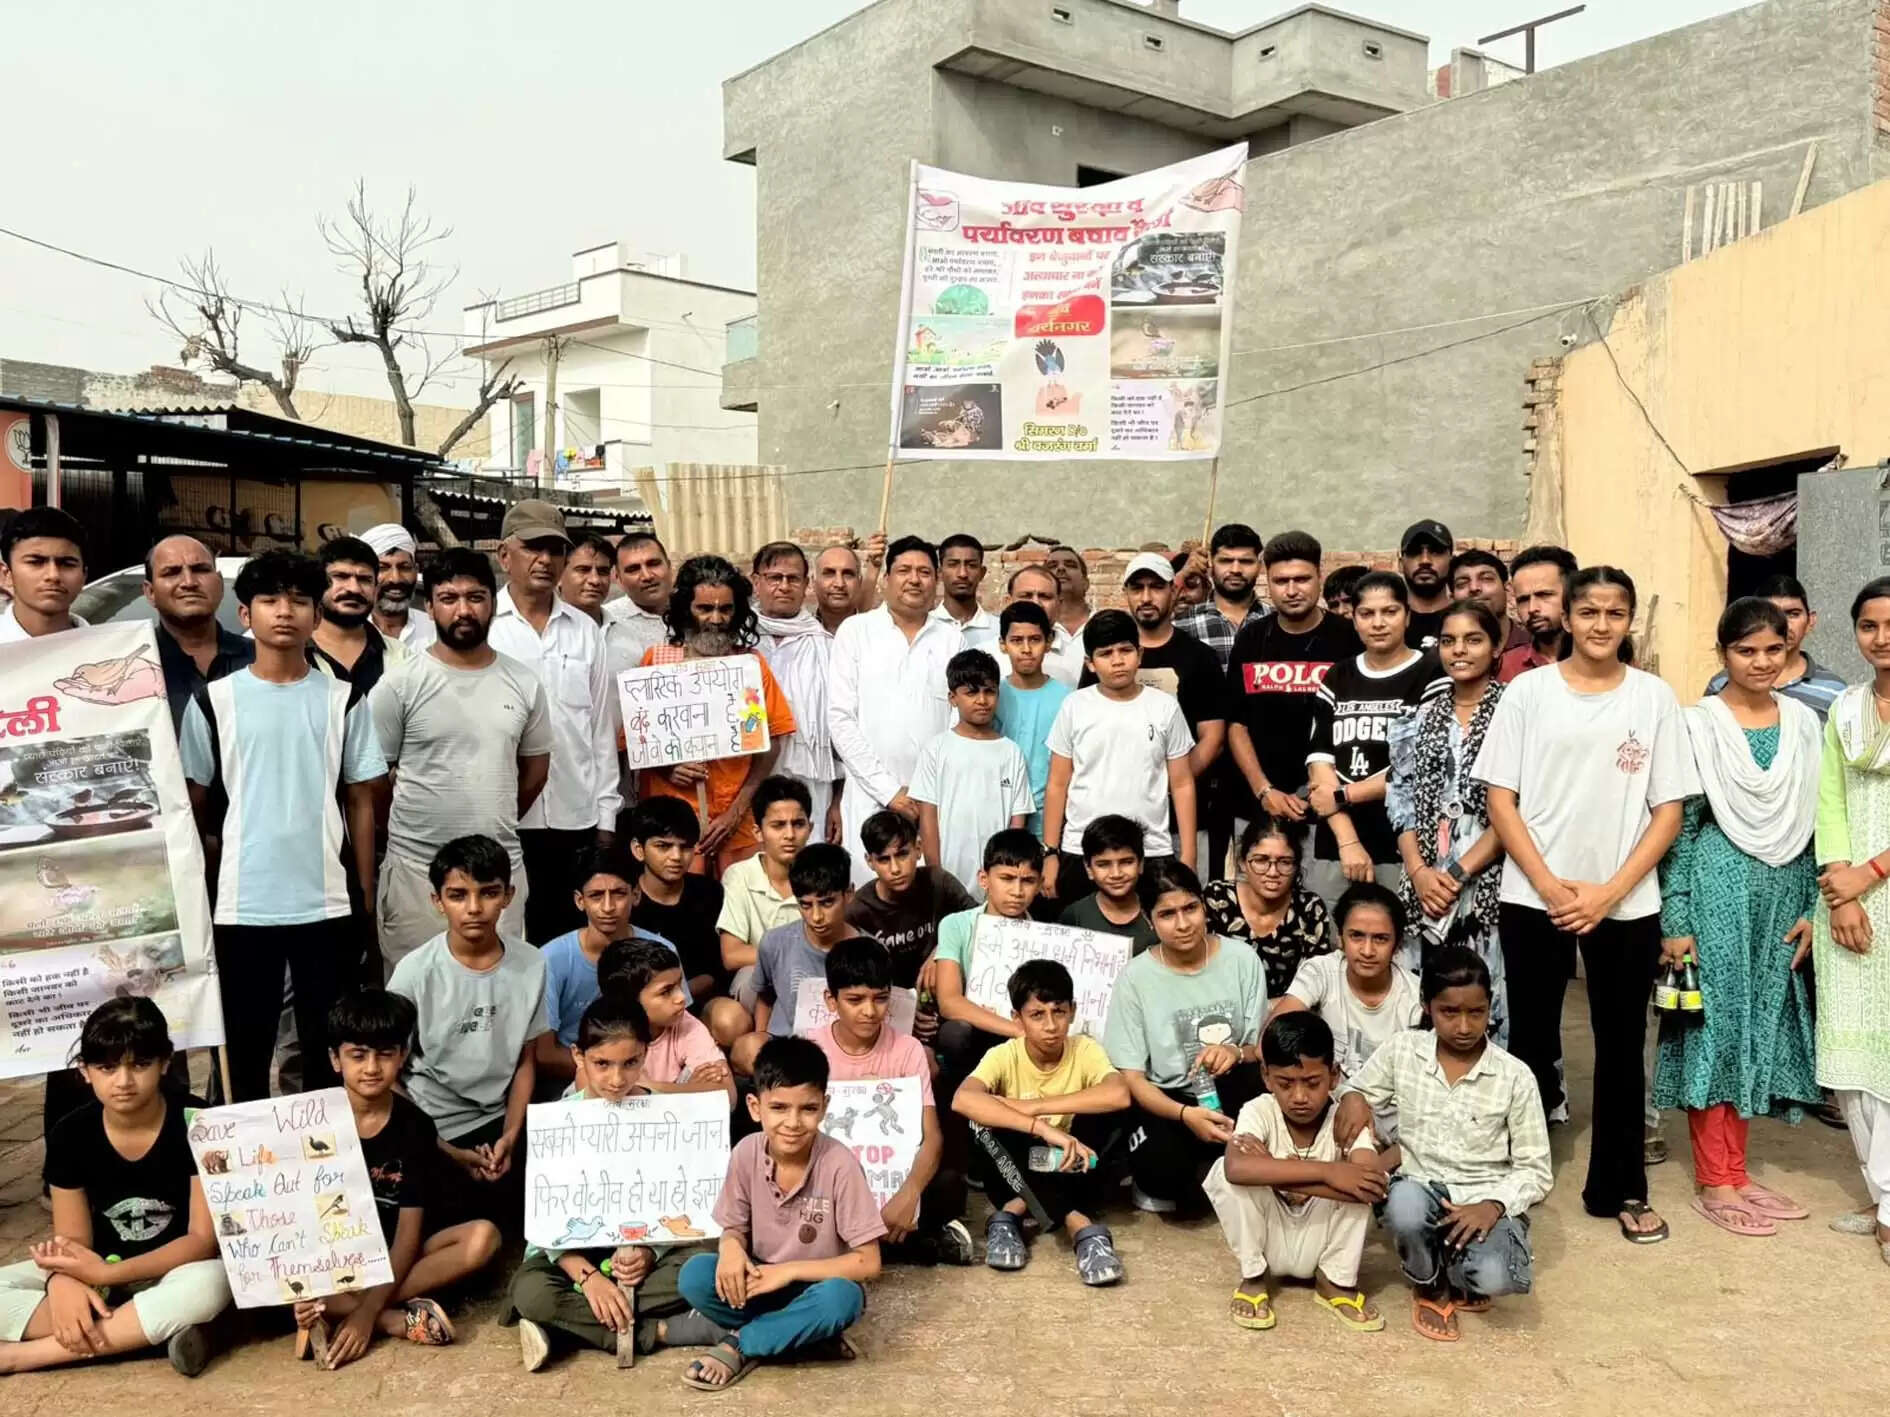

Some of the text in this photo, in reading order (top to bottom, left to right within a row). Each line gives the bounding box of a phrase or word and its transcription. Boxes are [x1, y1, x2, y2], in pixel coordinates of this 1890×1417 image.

[962, 221, 1065, 245] पर्यावरण
[1067, 226, 1130, 245] बचाव
[2, 976, 27, 988] किसी
[63, 969, 80, 979] नहीं
[3, 987, 28, 998] किसी
[8, 1009, 35, 1019] किसी
[272, 1098, 331, 1133] Wild
[622, 1111, 680, 1153] अपनी
[852, 1145, 896, 1165] TOP
